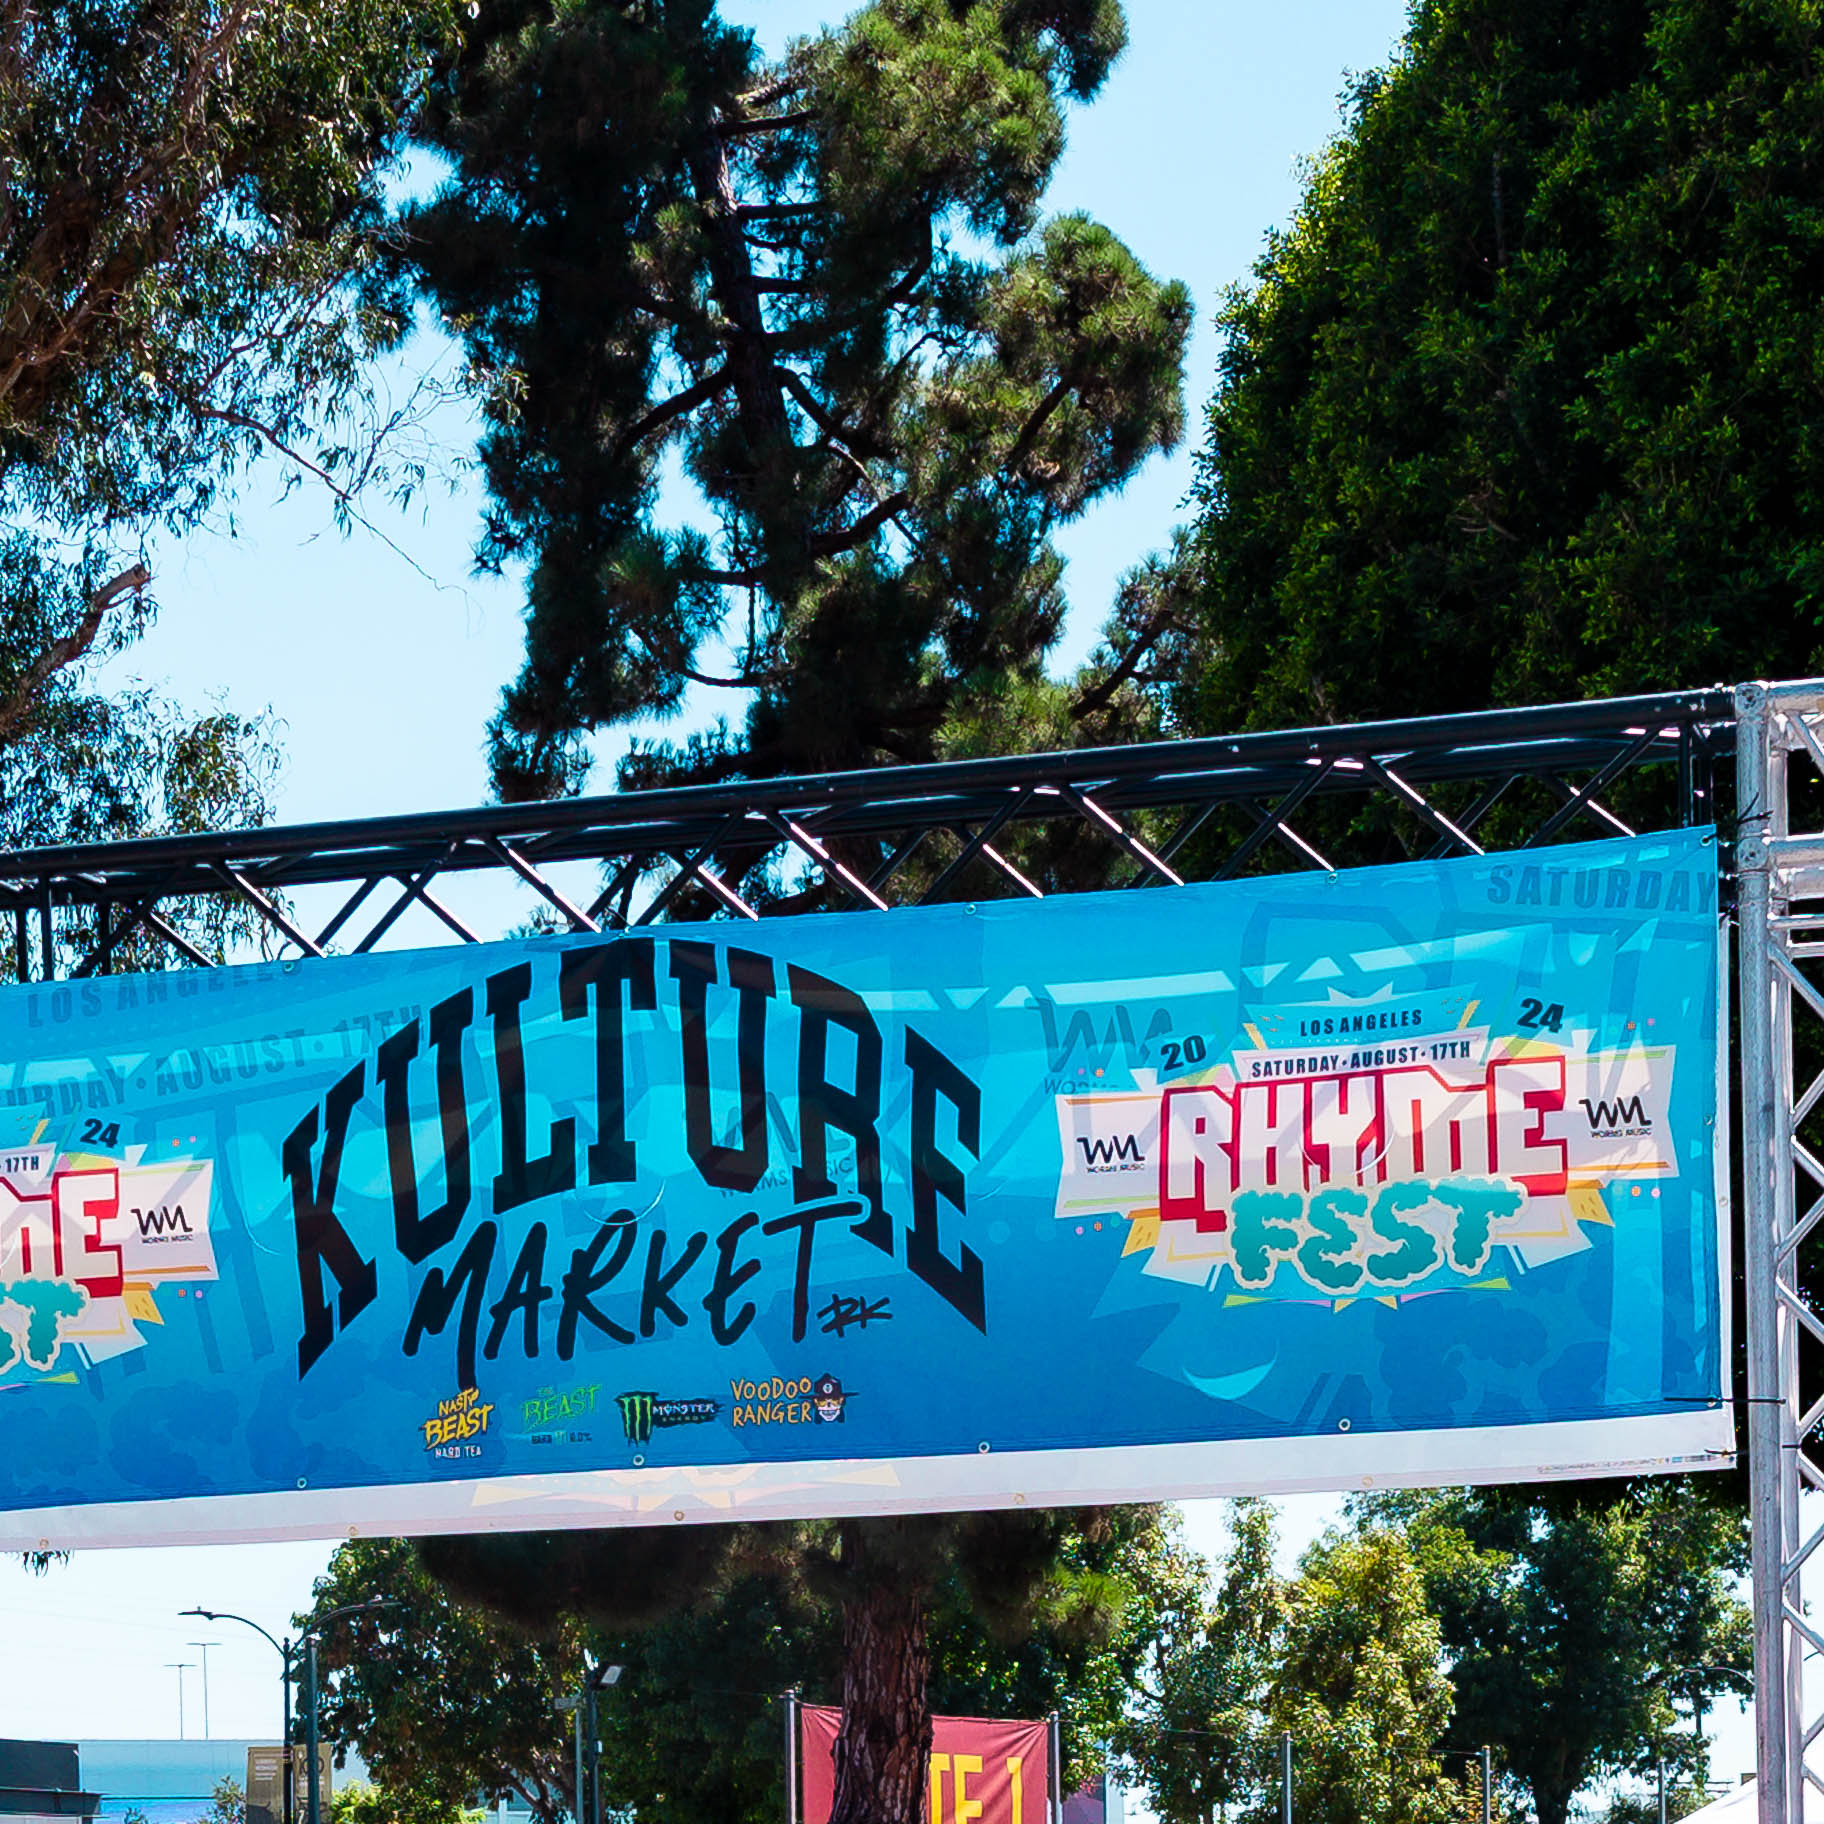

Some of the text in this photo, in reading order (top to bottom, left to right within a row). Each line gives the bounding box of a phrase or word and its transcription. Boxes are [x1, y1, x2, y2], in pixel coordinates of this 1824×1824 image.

[1159, 997, 1565, 1071] 20 LOS ANGELES 24
[1251, 1042, 1472, 1079] SATURDAY AUGUST 17TH
[79, 1118, 120, 1149] 24
[1159, 1056, 1568, 1233] RHYME
[5, 1156, 40, 1172] 17TH
[281, 936, 988, 1382] KULTURE
[1226, 1178, 1529, 1294] FEST
[402, 1199, 872, 1389] MARKET
[438, 1387, 480, 1416] NASTY
[731, 1376, 812, 1401] VOODOO
[425, 1405, 494, 1450] BEAST
[652, 1404, 715, 1415] MONSTER
[731, 1399, 812, 1427] RANGER
